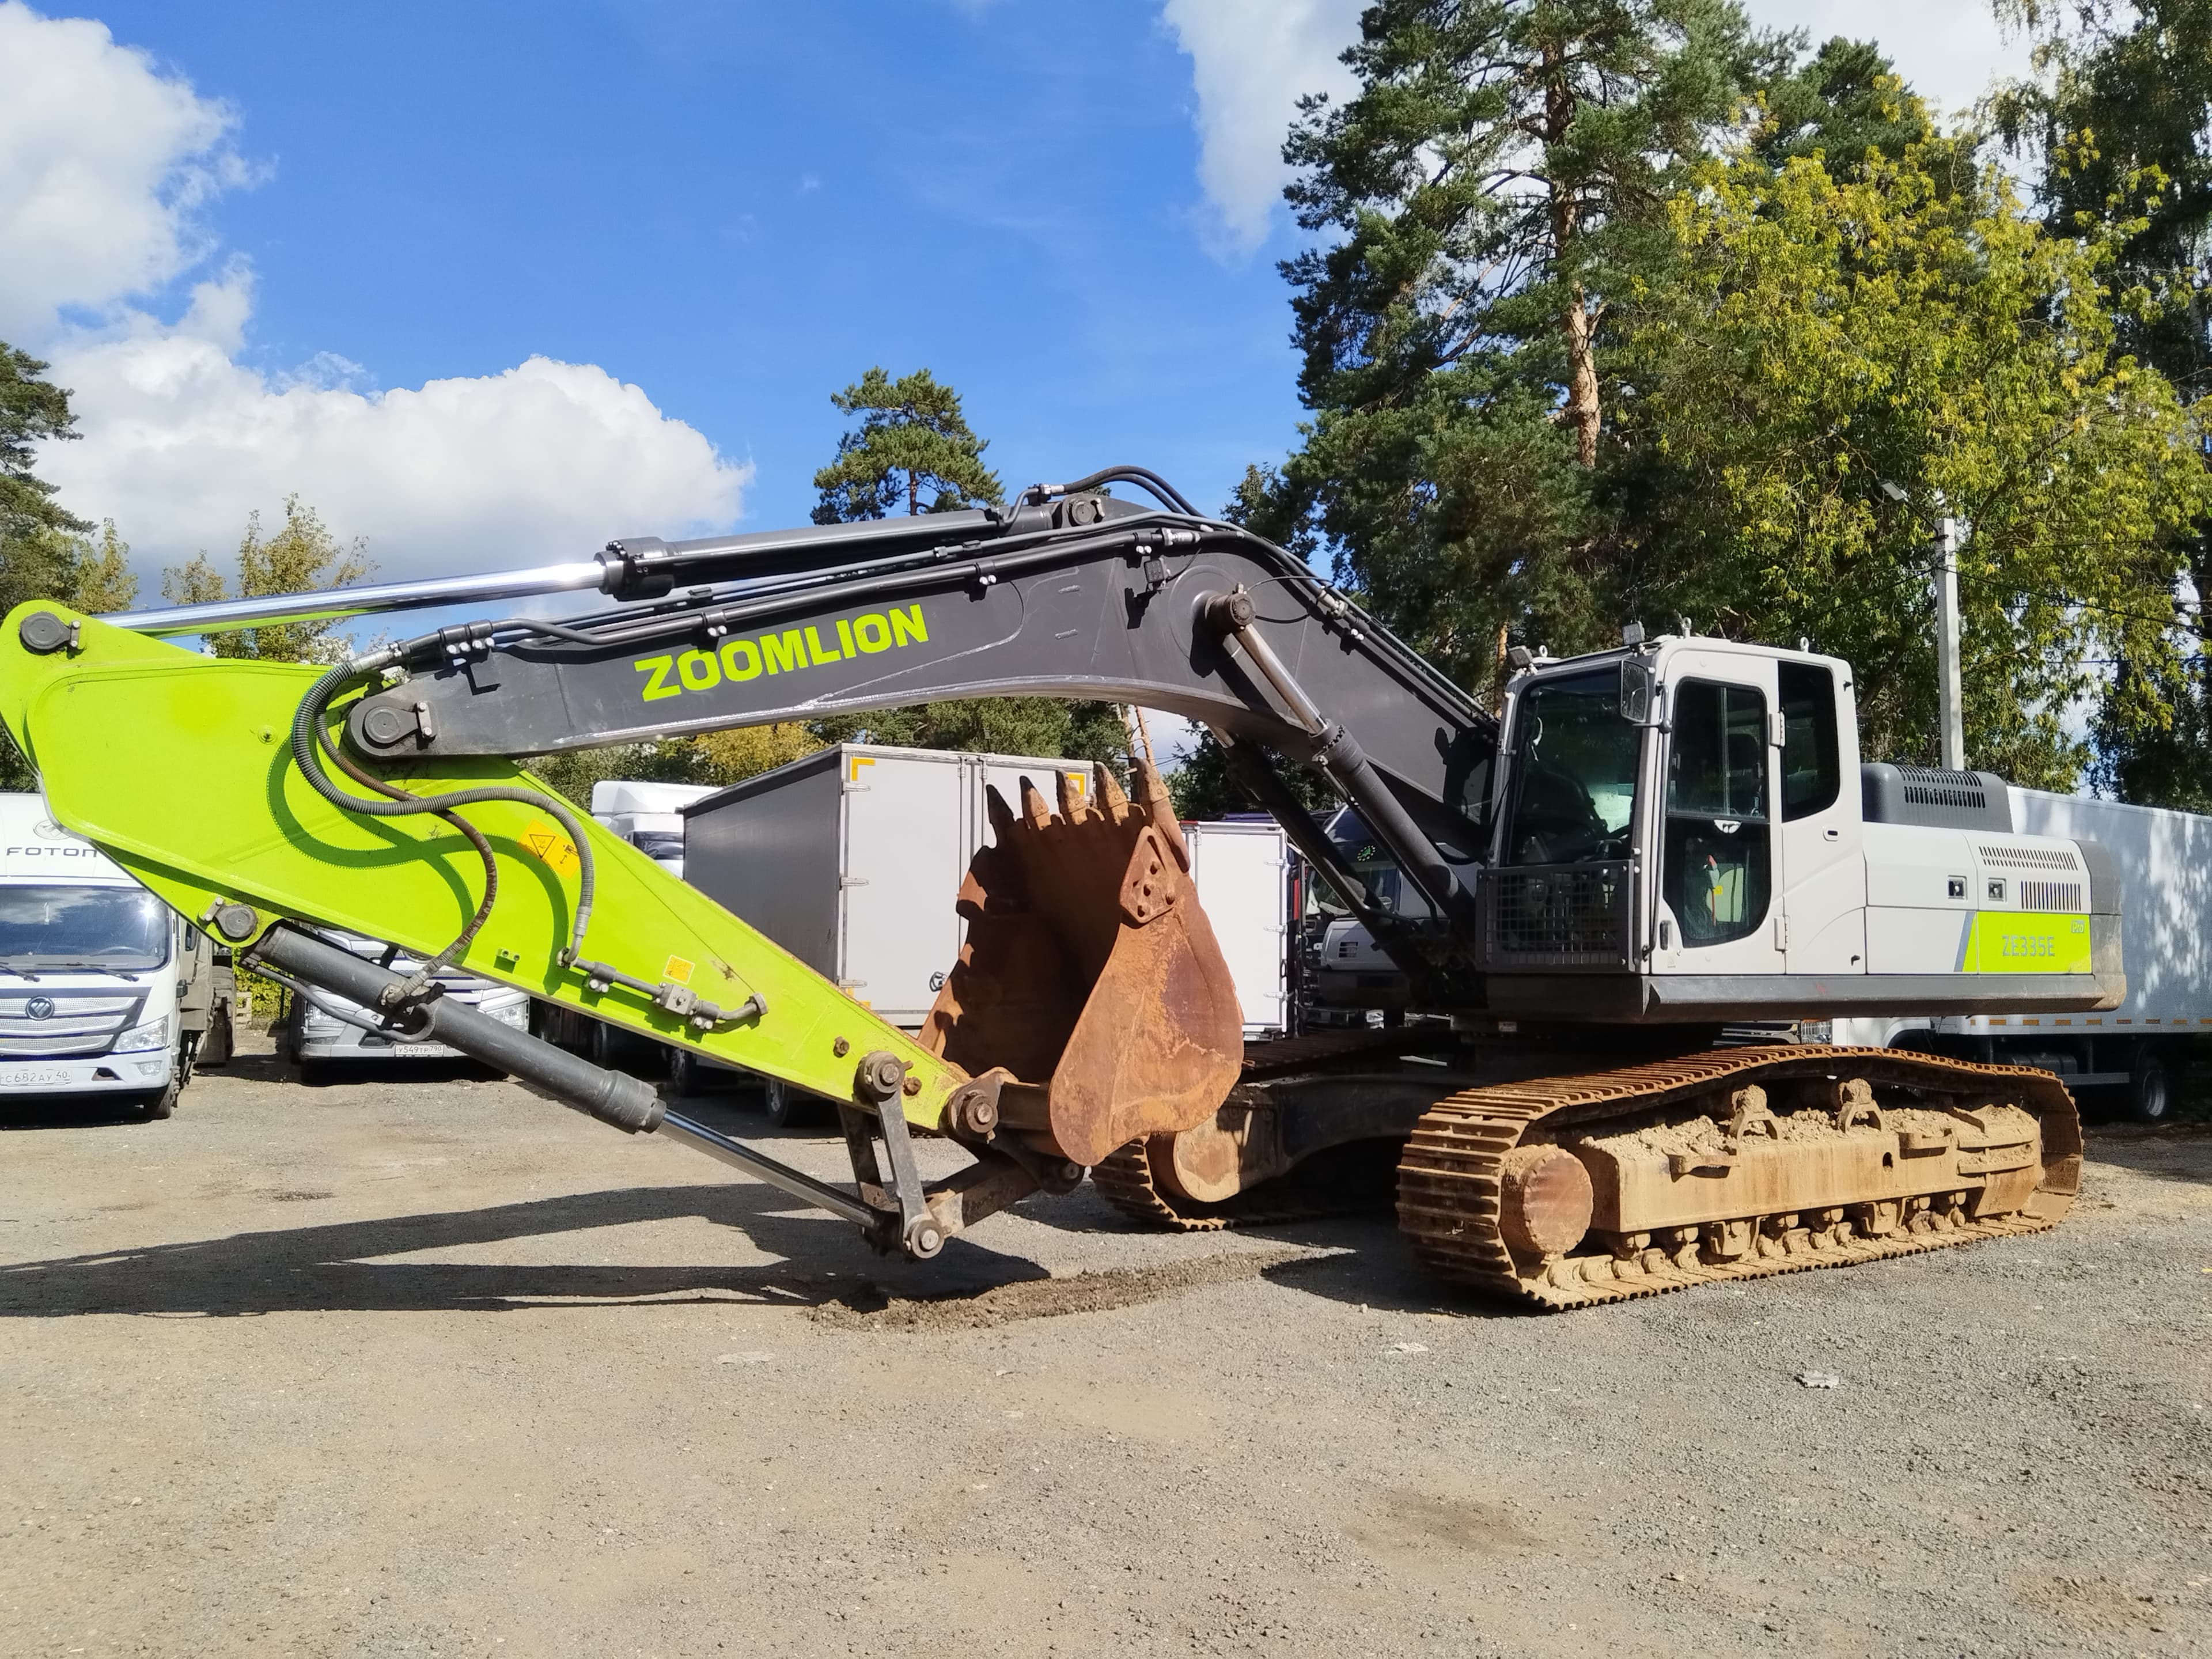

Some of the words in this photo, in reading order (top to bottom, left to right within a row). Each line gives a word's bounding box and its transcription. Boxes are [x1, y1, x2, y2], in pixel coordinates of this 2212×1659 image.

[634, 604, 929, 702] ZOOMLION
[6, 847, 97, 858] FOTON
[2002, 935, 2055, 957] ZE335E
